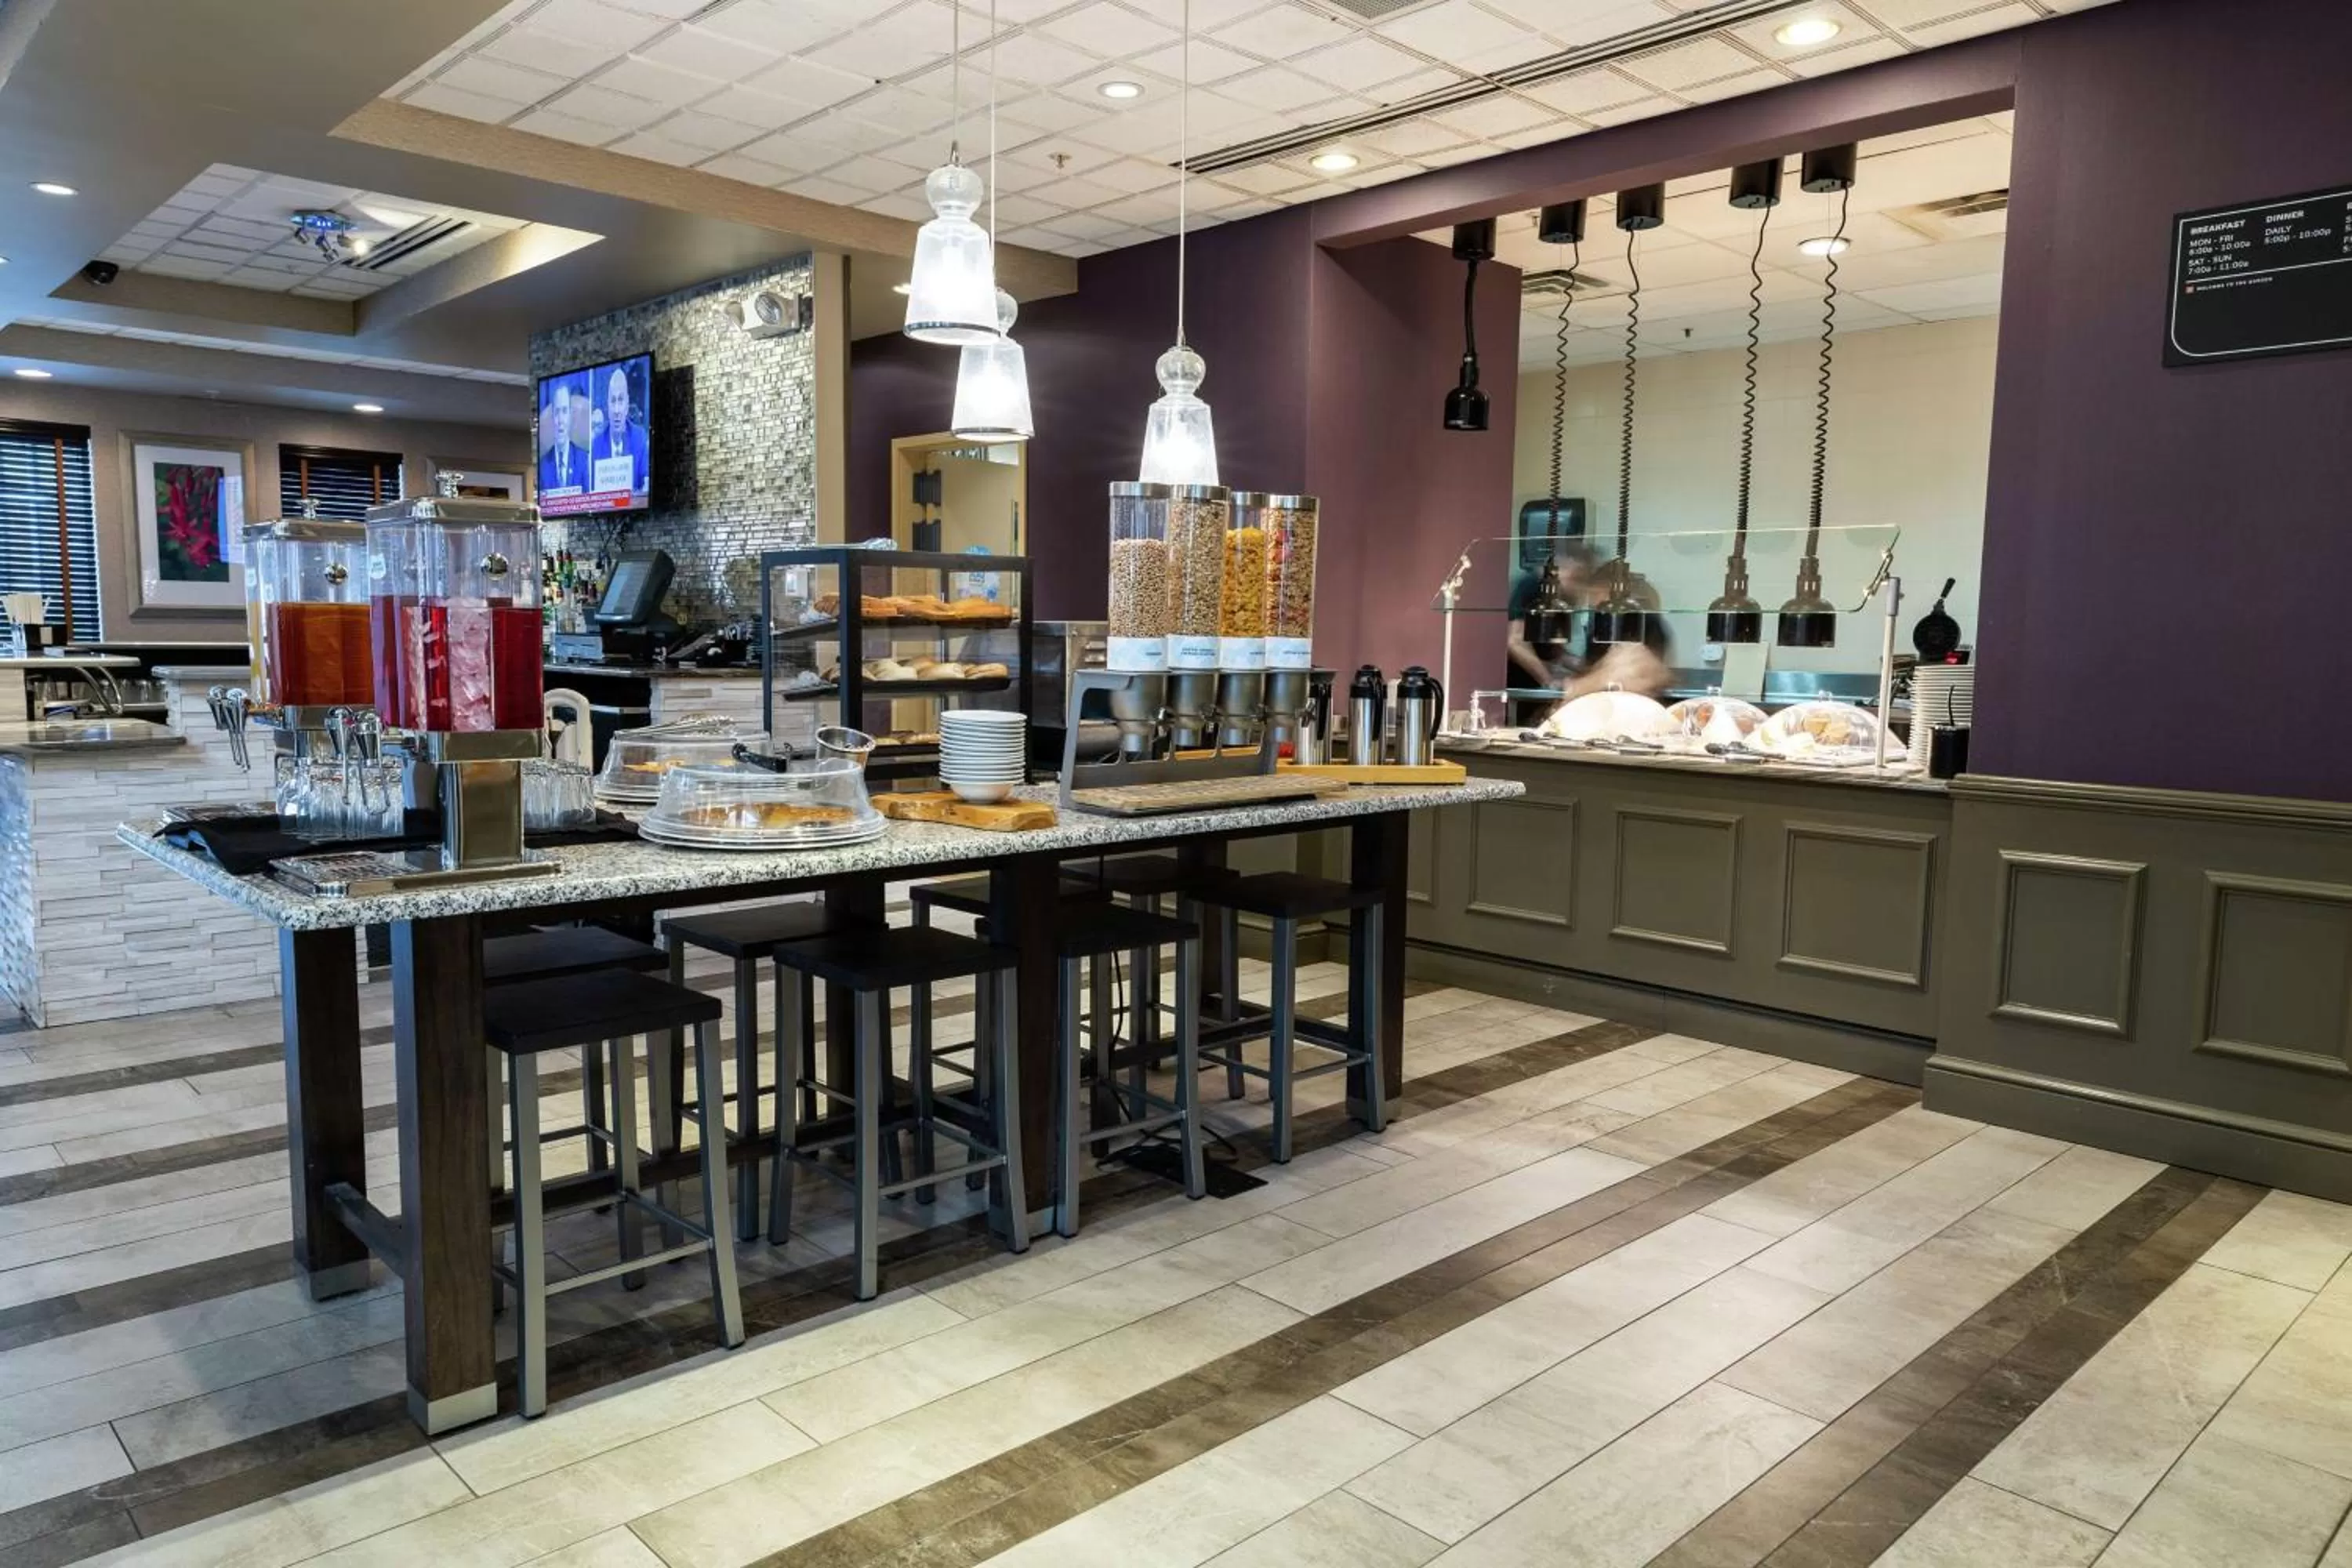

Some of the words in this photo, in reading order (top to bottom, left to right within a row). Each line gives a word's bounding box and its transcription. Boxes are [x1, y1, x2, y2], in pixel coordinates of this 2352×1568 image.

[2266, 210, 2304, 223] DINNER
[2190, 220, 2245, 234] BREAKFAST
[2264, 225, 2292, 236] DAILY
[2190, 238, 2212, 248] MON
[2219, 234, 2234, 243] FRI
[2188, 258, 2205, 267] SAT
[2212, 254, 2232, 264] SUN
